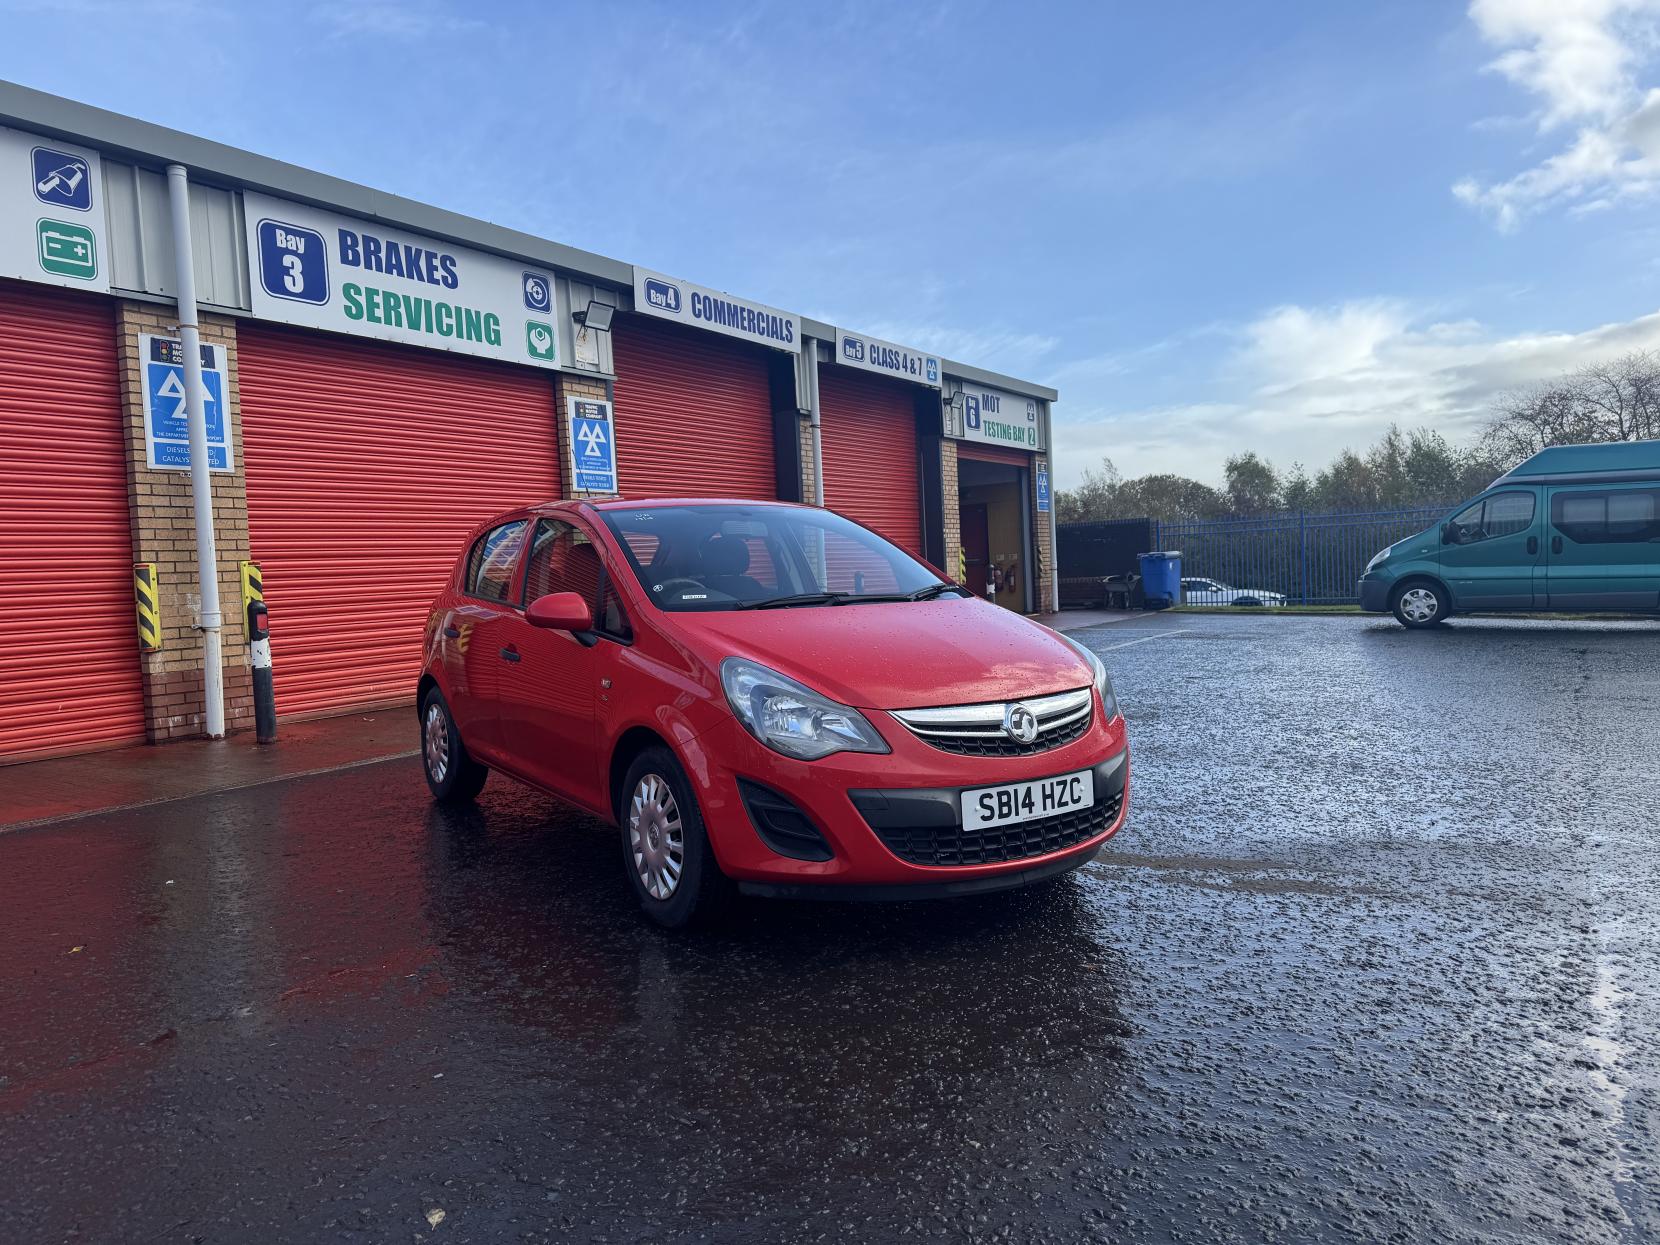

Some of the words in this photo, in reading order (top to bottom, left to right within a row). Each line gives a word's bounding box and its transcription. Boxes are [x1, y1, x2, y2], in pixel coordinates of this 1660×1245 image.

[275, 228, 305, 254] Bay
[283, 254, 304, 294] 3
[337, 228, 459, 290] BRAKES
[342, 282, 502, 347] SERVICING
[650, 289, 666, 307] Bay
[666, 287, 676, 309] 4
[691, 292, 793, 344] COMMERCIALS
[869, 343, 900, 371] CLASS
[902, 352, 908, 373] 4
[910, 358, 916, 375] &
[918, 356, 922, 376] 7
[970, 409, 976, 427] 6
[982, 393, 1000, 413] MOT
[983, 420, 1011, 440] TESTING
[1012, 425, 1025, 443] BAY
[979, 786, 1035, 822] SB14
[1041, 777, 1082, 811] HZC
